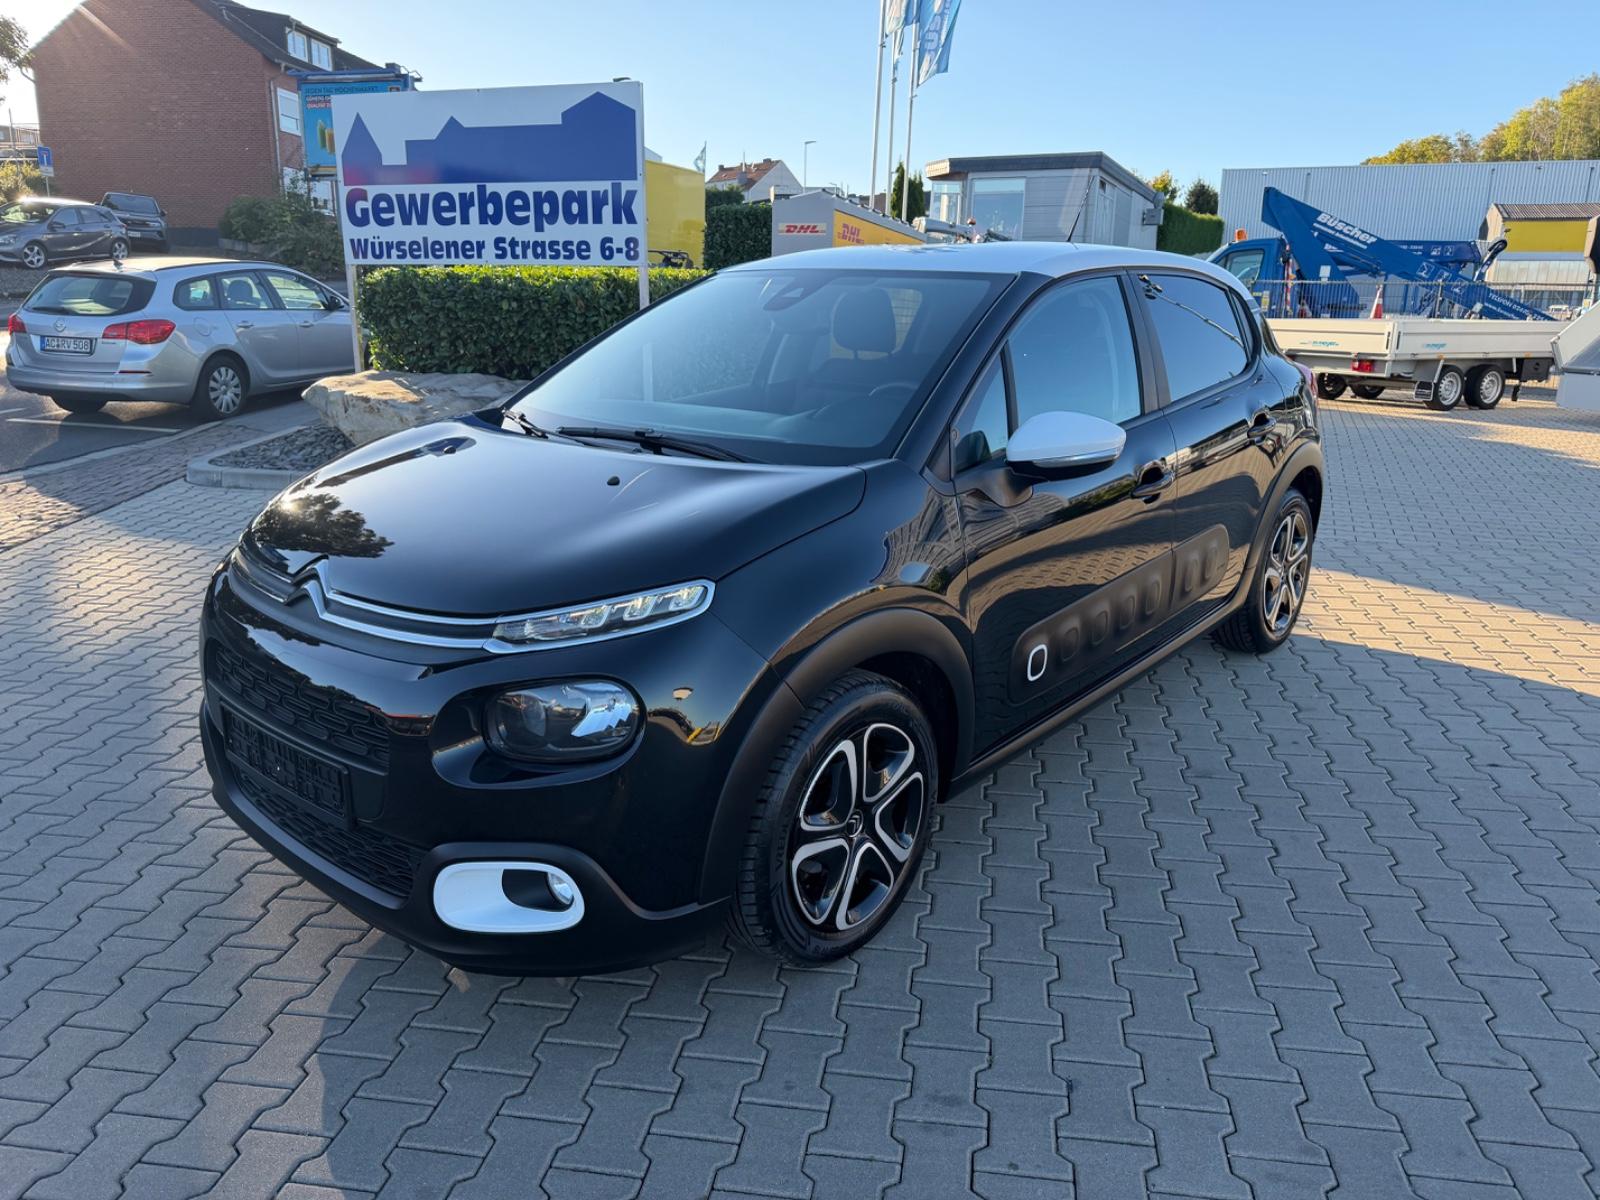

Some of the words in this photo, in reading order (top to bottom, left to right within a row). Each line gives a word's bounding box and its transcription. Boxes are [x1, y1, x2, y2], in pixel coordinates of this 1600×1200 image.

[346, 183, 638, 232] Gewerbepark
[785, 225, 819, 233] DHL
[350, 236, 486, 260] Würselener
[494, 236, 591, 260] Strasse
[600, 236, 640, 261] 6-8
